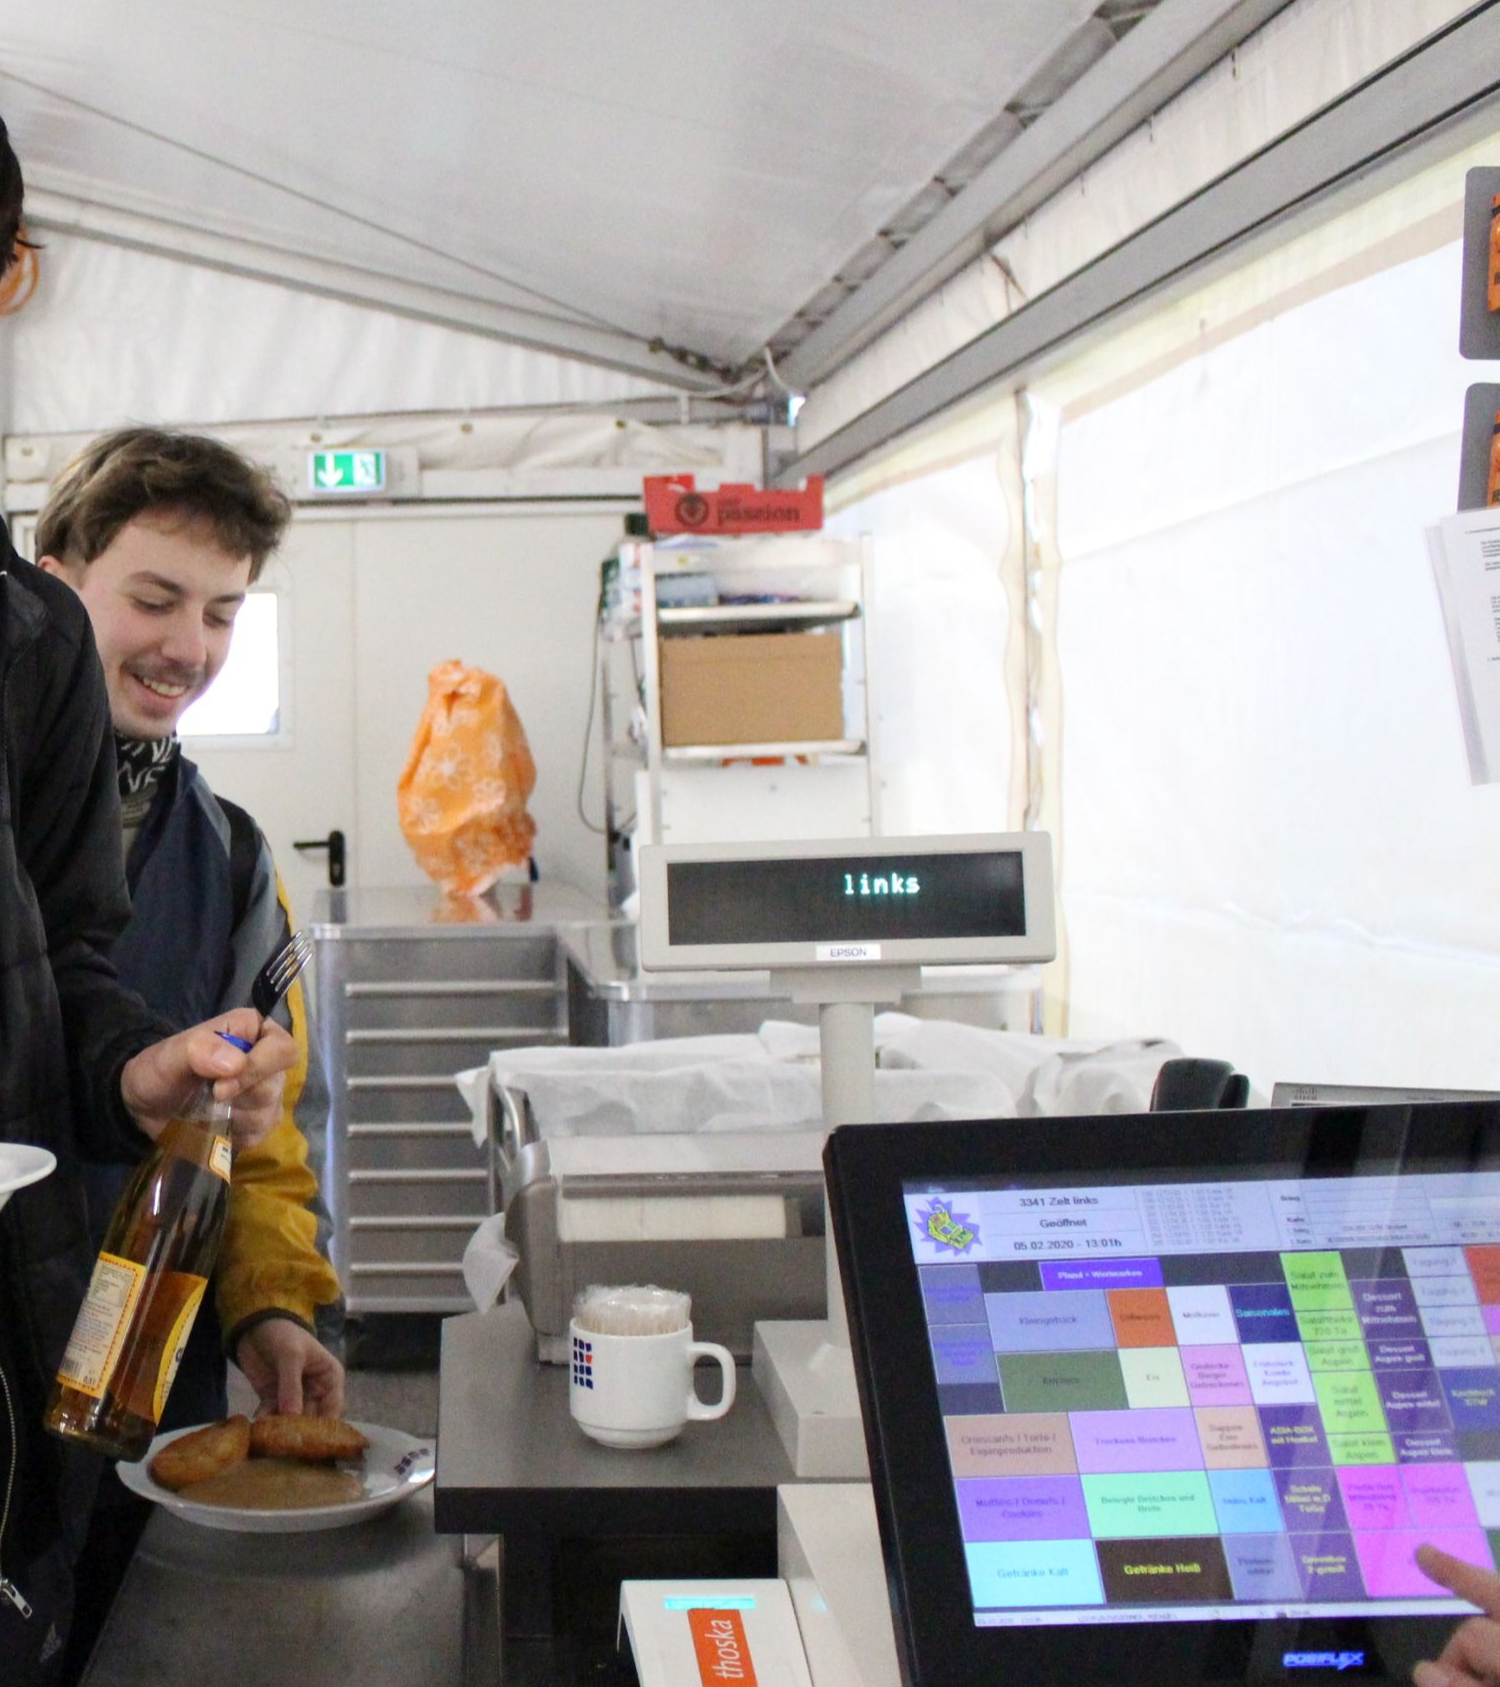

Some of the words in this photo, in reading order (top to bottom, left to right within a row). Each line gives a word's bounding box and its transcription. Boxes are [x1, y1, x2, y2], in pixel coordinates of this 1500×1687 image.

[843, 873, 921, 895] links
[829, 947, 868, 958] EPSON
[1019, 1198, 1045, 1207] 3341
[1049, 1197, 1071, 1206] Zelt
[1072, 1196, 1099, 1205] links
[1039, 1218, 1088, 1228] Geöffnet
[1013, 1240, 1074, 1251] 05.02.2020
[704, 1617, 744, 1680] thoska
